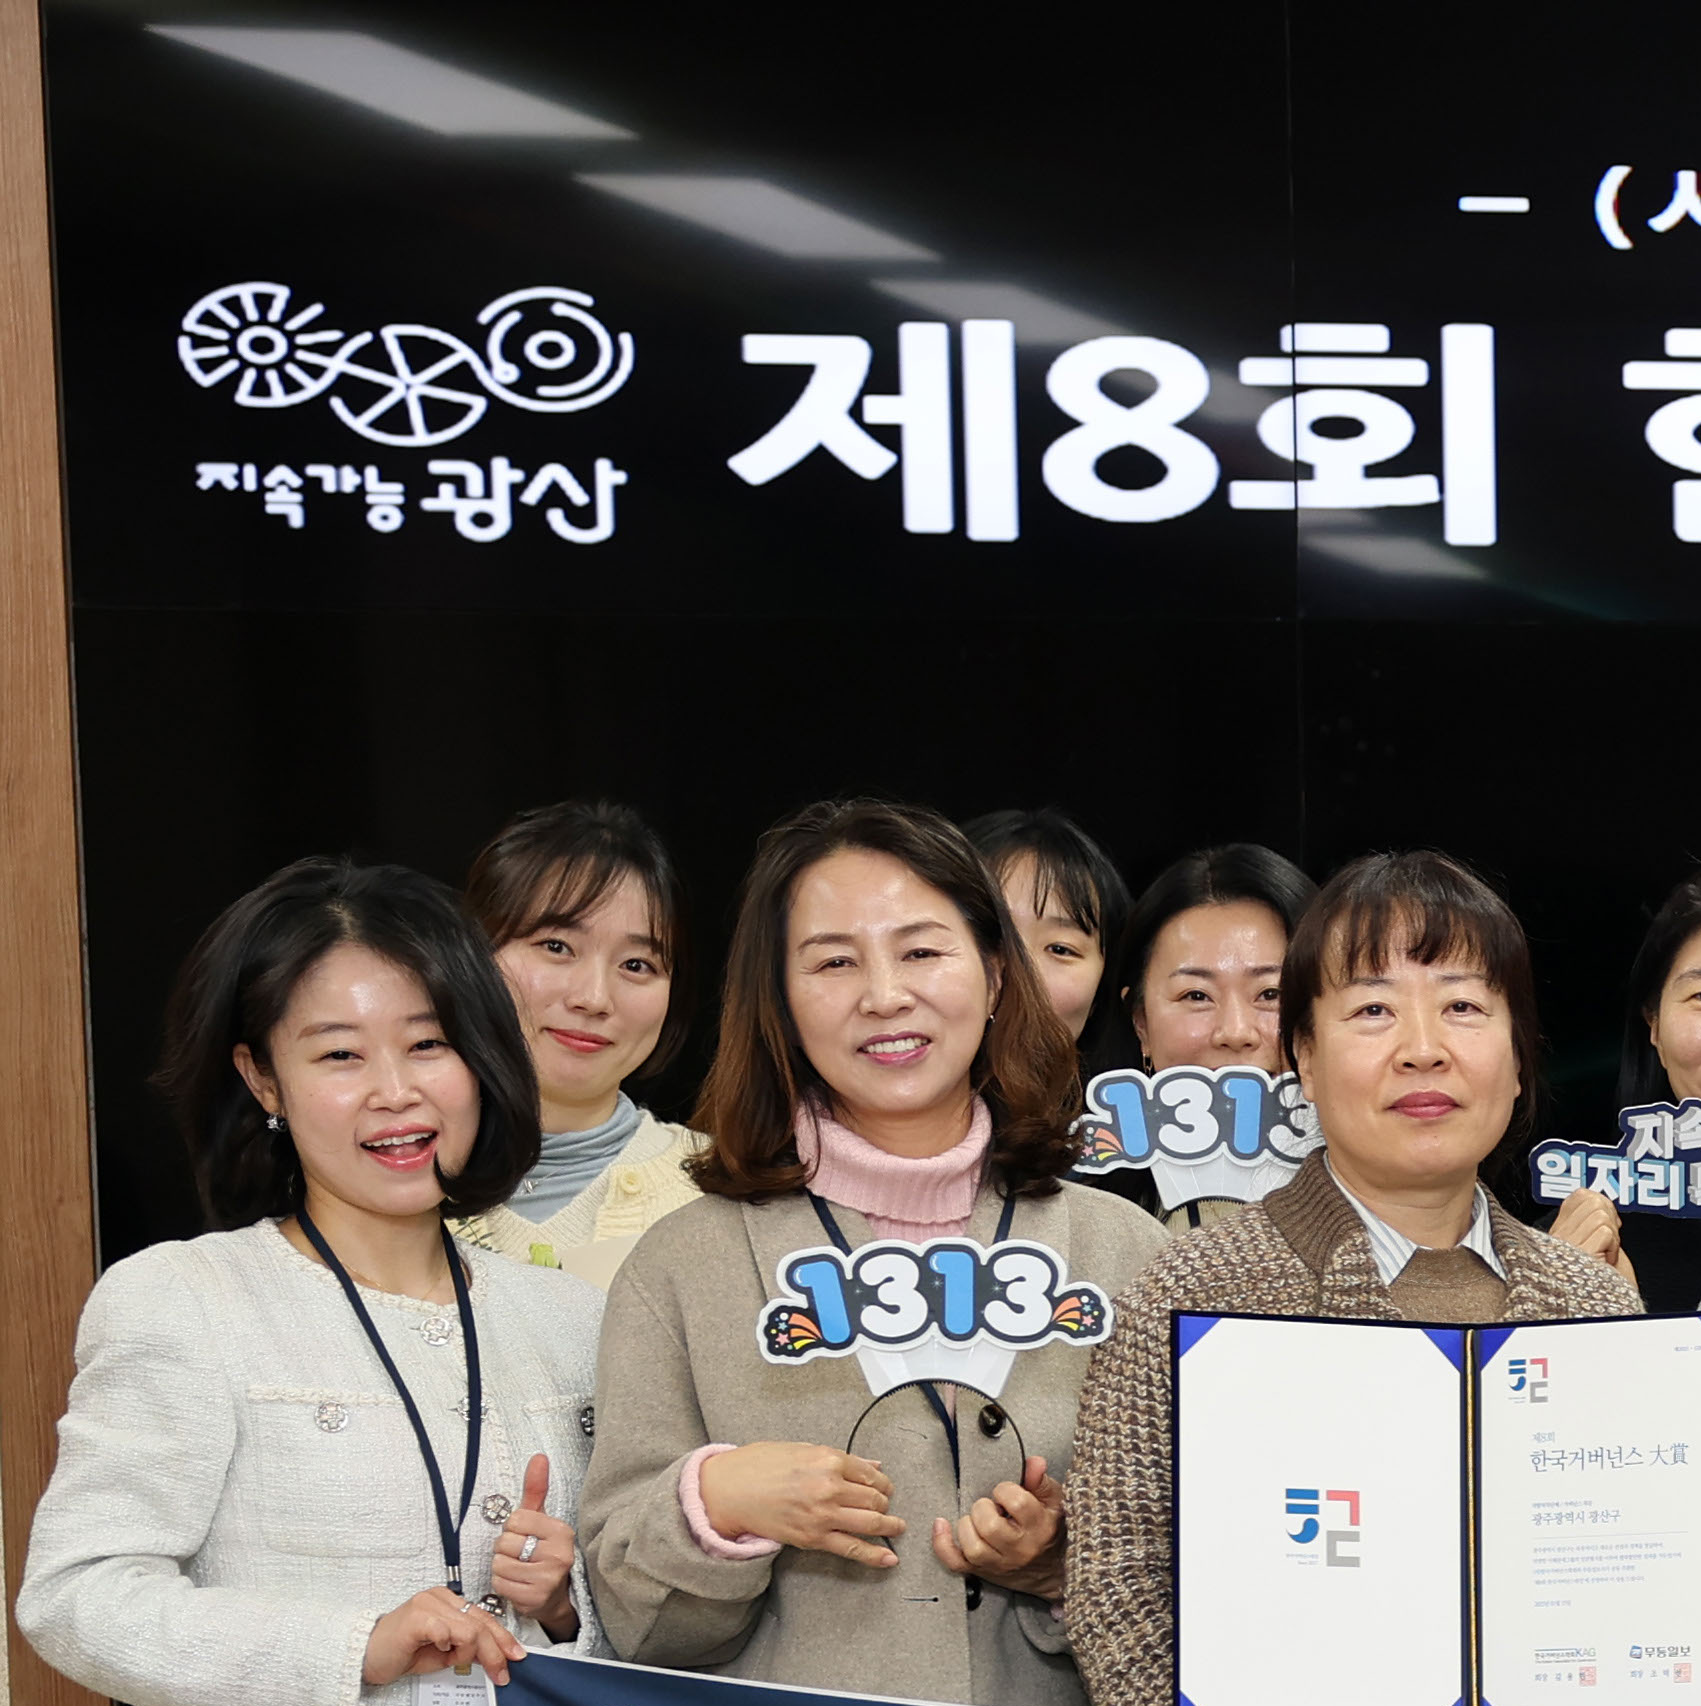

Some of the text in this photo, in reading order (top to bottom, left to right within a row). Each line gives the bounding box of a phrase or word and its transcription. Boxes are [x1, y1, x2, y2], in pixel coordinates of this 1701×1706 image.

[727, 318, 1496, 546] 제8회
[196, 456, 628, 544] 지속가능 광산
[1100, 1076, 1327, 1158] 1313
[1536, 1148, 1686, 1211] 일자리
[790, 1248, 1055, 1347] 1313
[1529, 1442, 1689, 1473] 한국거버넌스 大賞
[1531, 1508, 1622, 1527] 광주광역시 광산구
[1644, 1645, 1692, 1659] 무등일보
